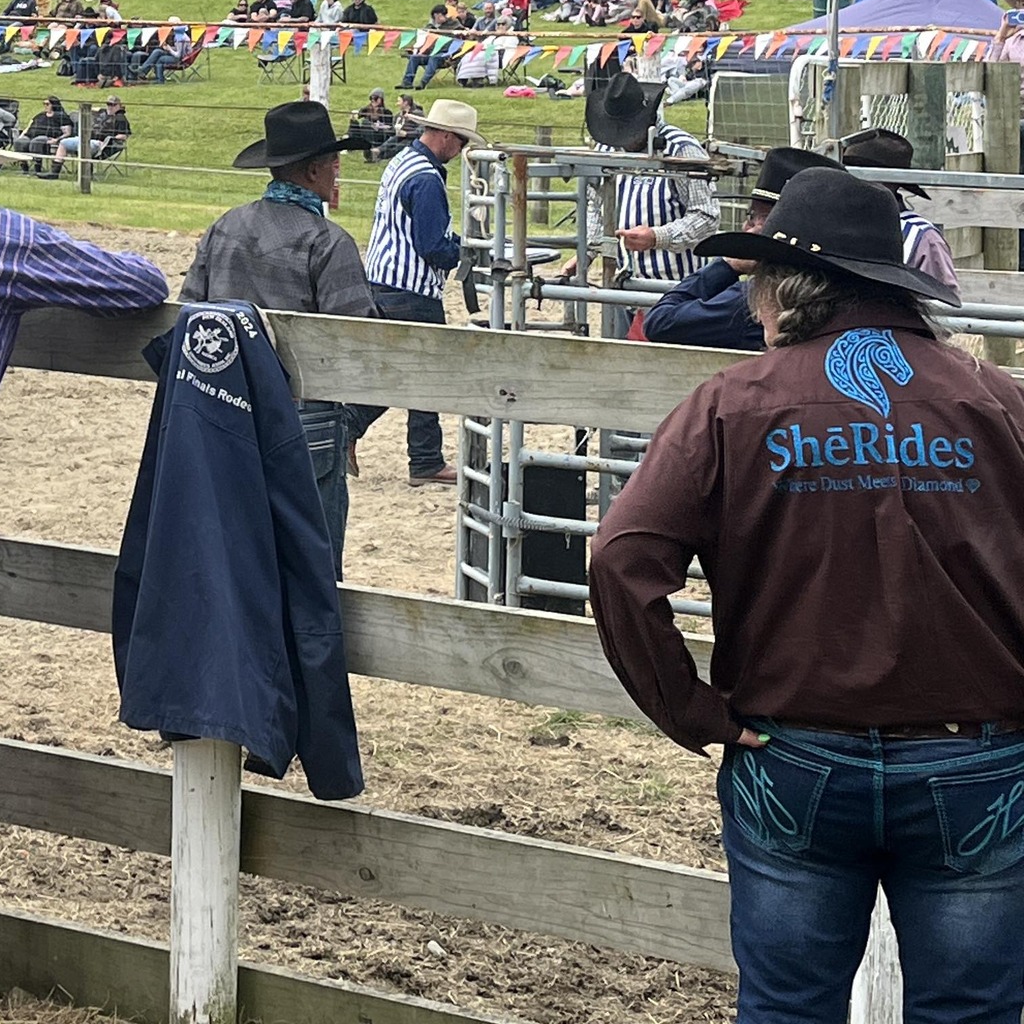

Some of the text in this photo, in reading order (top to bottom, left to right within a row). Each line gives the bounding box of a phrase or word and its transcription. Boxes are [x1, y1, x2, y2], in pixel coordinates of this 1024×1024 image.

[236, 311, 257, 338] 2024
[186, 371, 217, 396] Finals
[217, 388, 253, 413] Rodeo
[772, 478, 817, 493] here
[820, 476, 855, 492] Dust
[900, 476, 965, 494] Diamond
